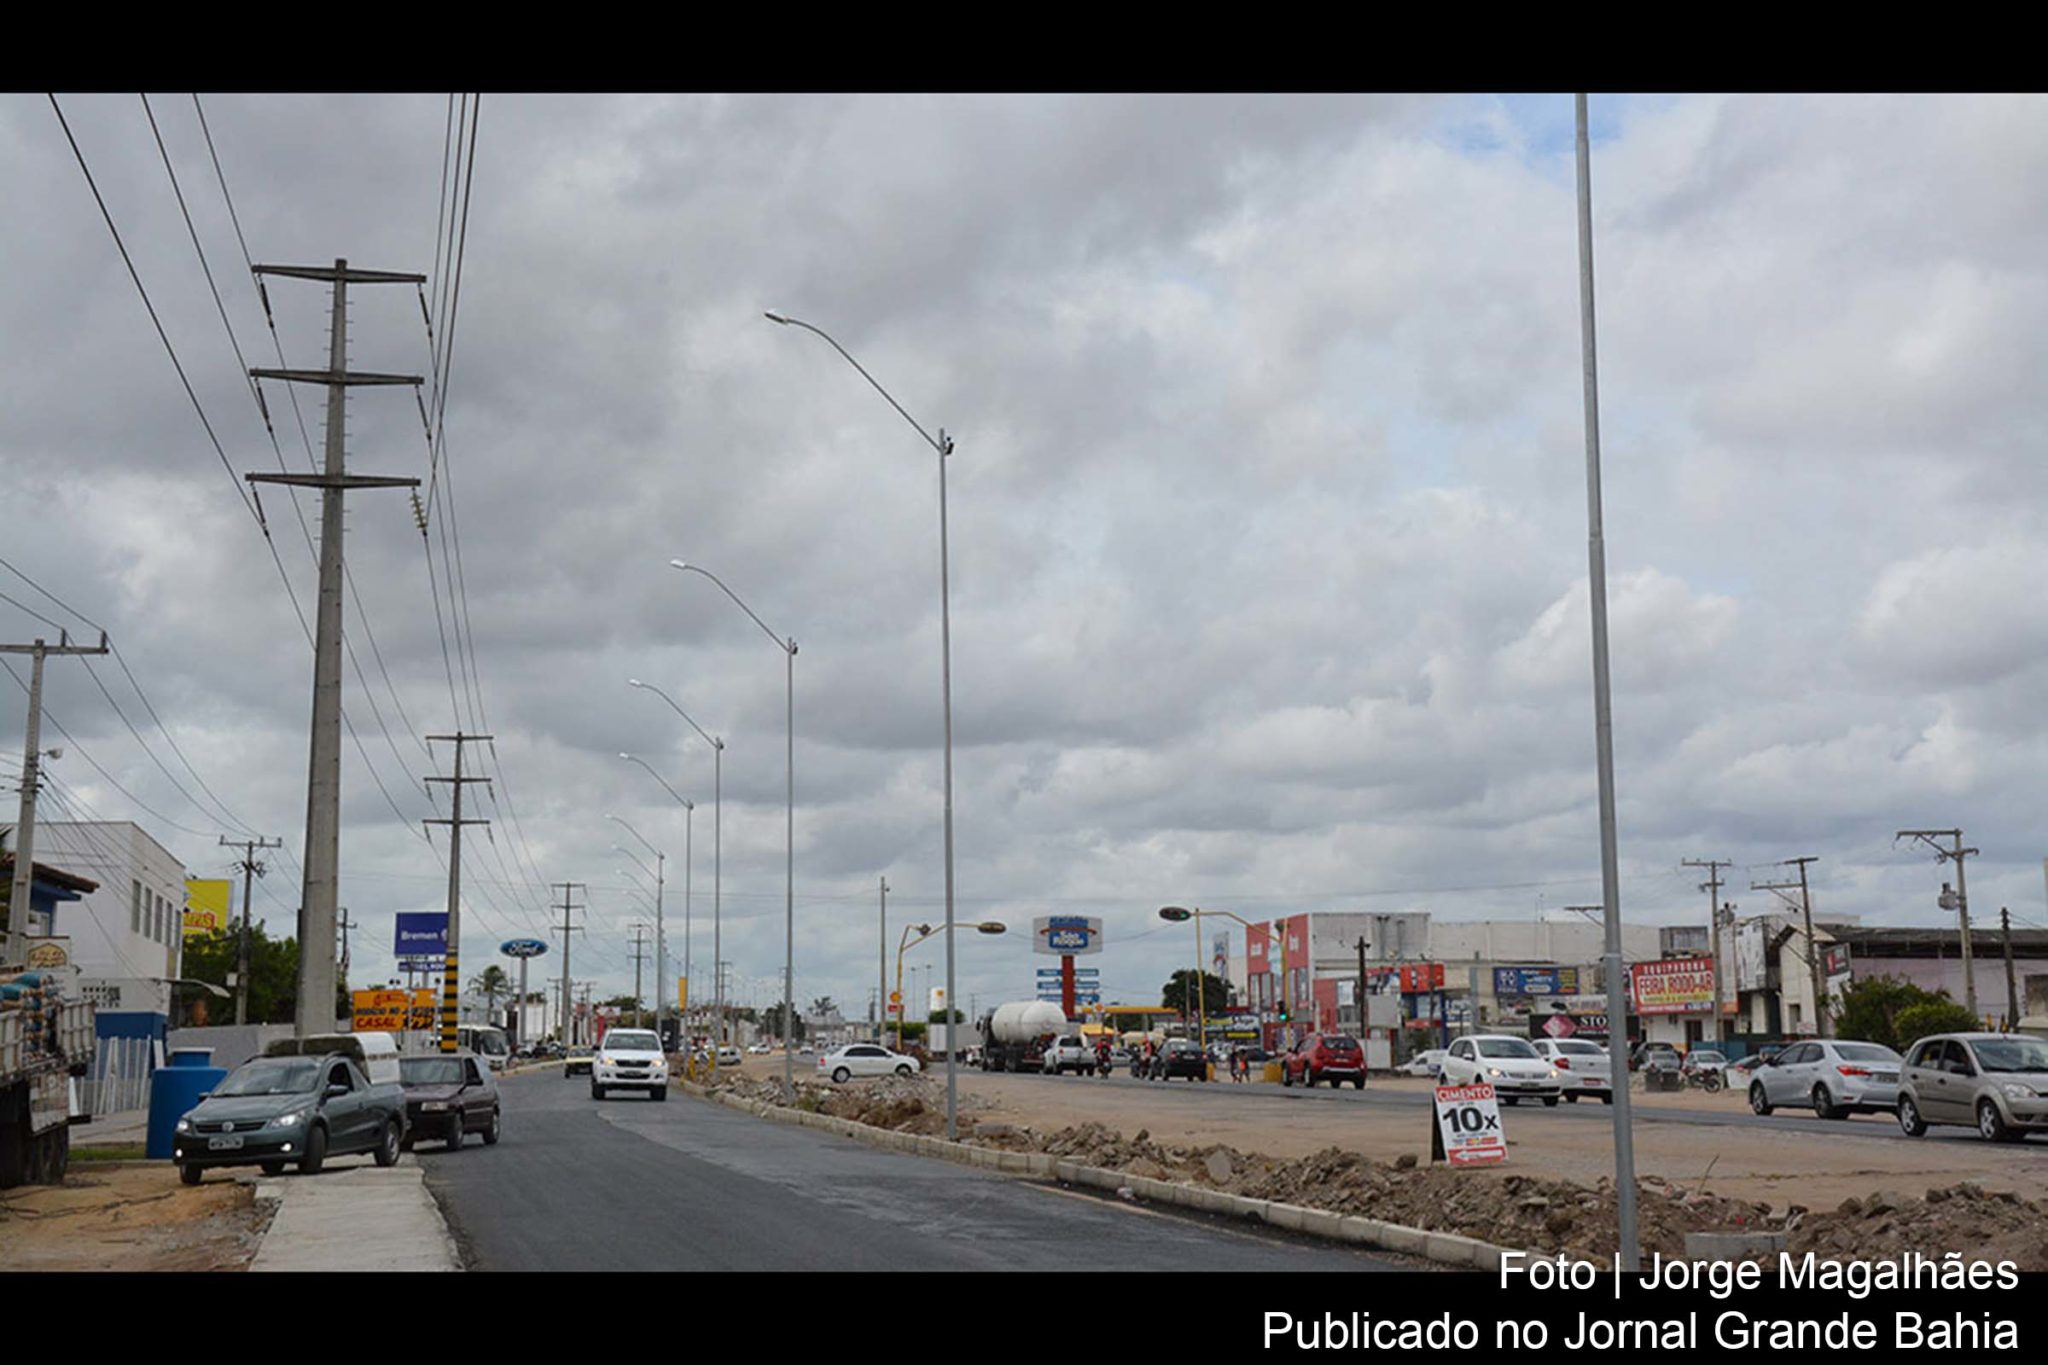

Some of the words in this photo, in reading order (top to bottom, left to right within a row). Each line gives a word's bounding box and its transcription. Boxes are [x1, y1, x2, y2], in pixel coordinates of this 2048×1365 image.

[401, 930, 439, 941] Bremen
[508, 941, 542, 956] Ford
[1640, 976, 1665, 996] FEIRA
[1667, 972, 1712, 994] RODO-AR
[355, 1016, 397, 1029] CASAL
[1437, 1086, 1493, 1103] CIMENTO
